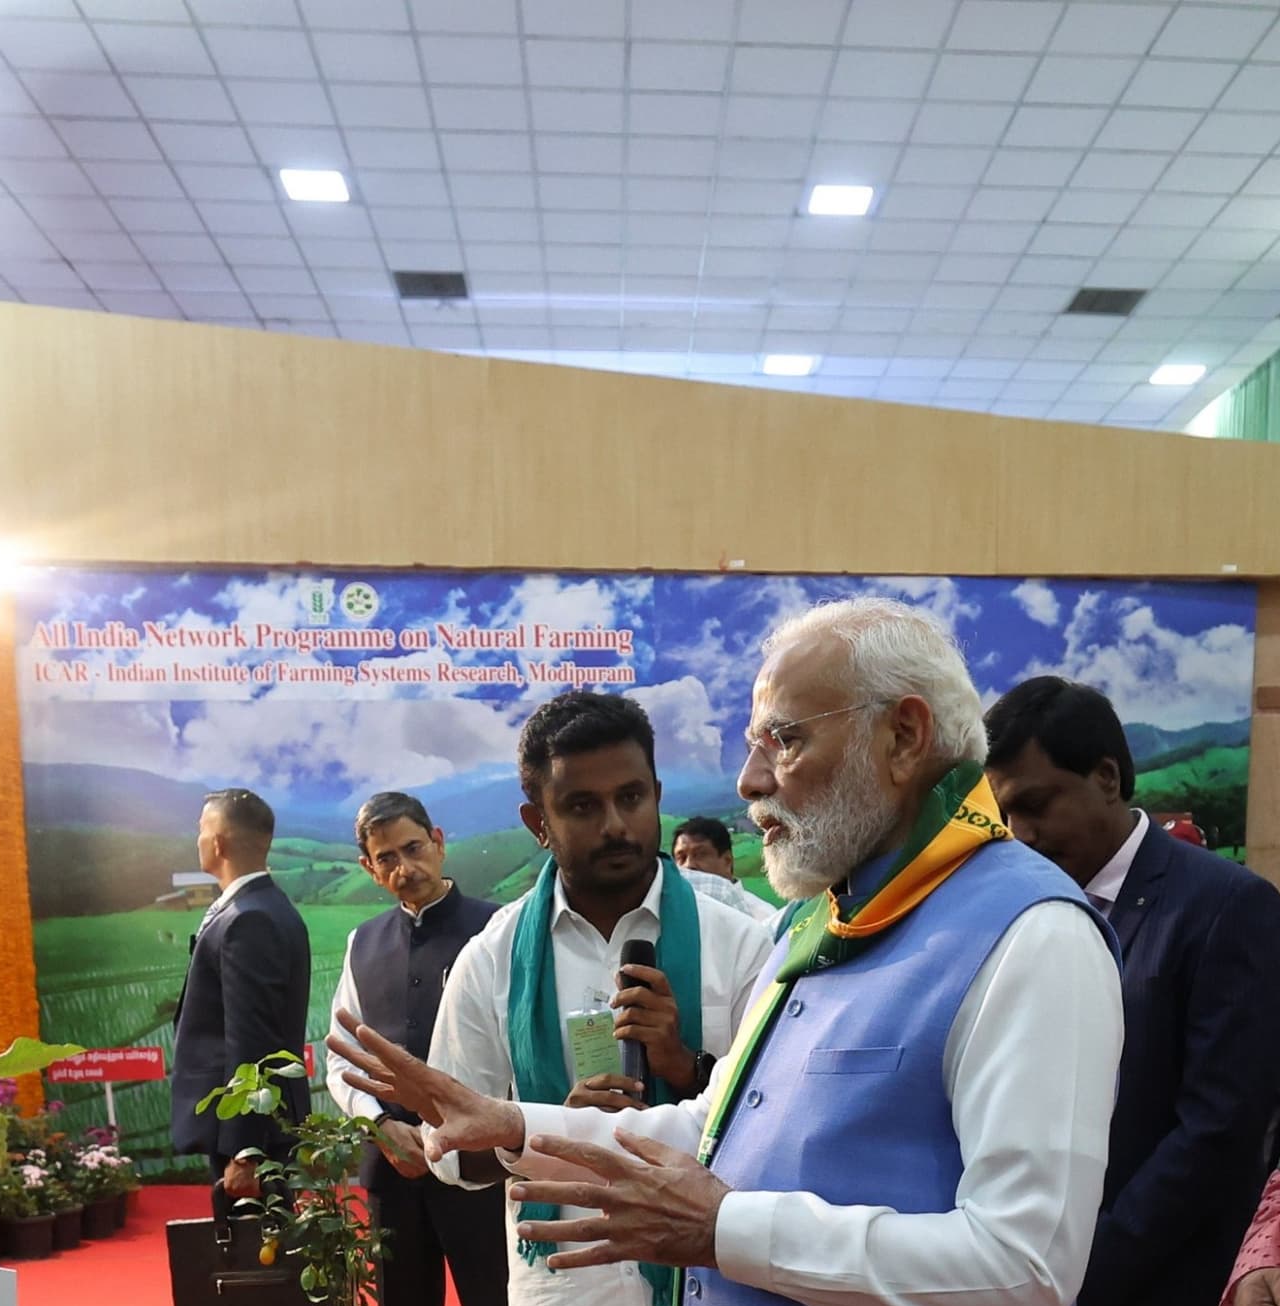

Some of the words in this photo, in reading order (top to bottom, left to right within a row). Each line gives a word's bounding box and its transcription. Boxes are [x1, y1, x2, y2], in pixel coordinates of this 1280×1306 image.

[35, 622, 67, 648] All
[74, 622, 138, 648] India
[145, 622, 247, 648] Network
[255, 624, 393, 652] Programme
[400, 629, 429, 648] on
[437, 624, 524, 648] Natural
[533, 624, 633, 652] Farming
[35, 662, 88, 682] ICAR
[108, 662, 166, 682] Indian
[173, 662, 248, 682] Institute
[254, 662, 273, 682] of
[278, 662, 354, 687] Farming
[360, 662, 431, 686] Systems
[437, 662, 522, 686] Research,
[528, 662, 634, 688] Modipuram
